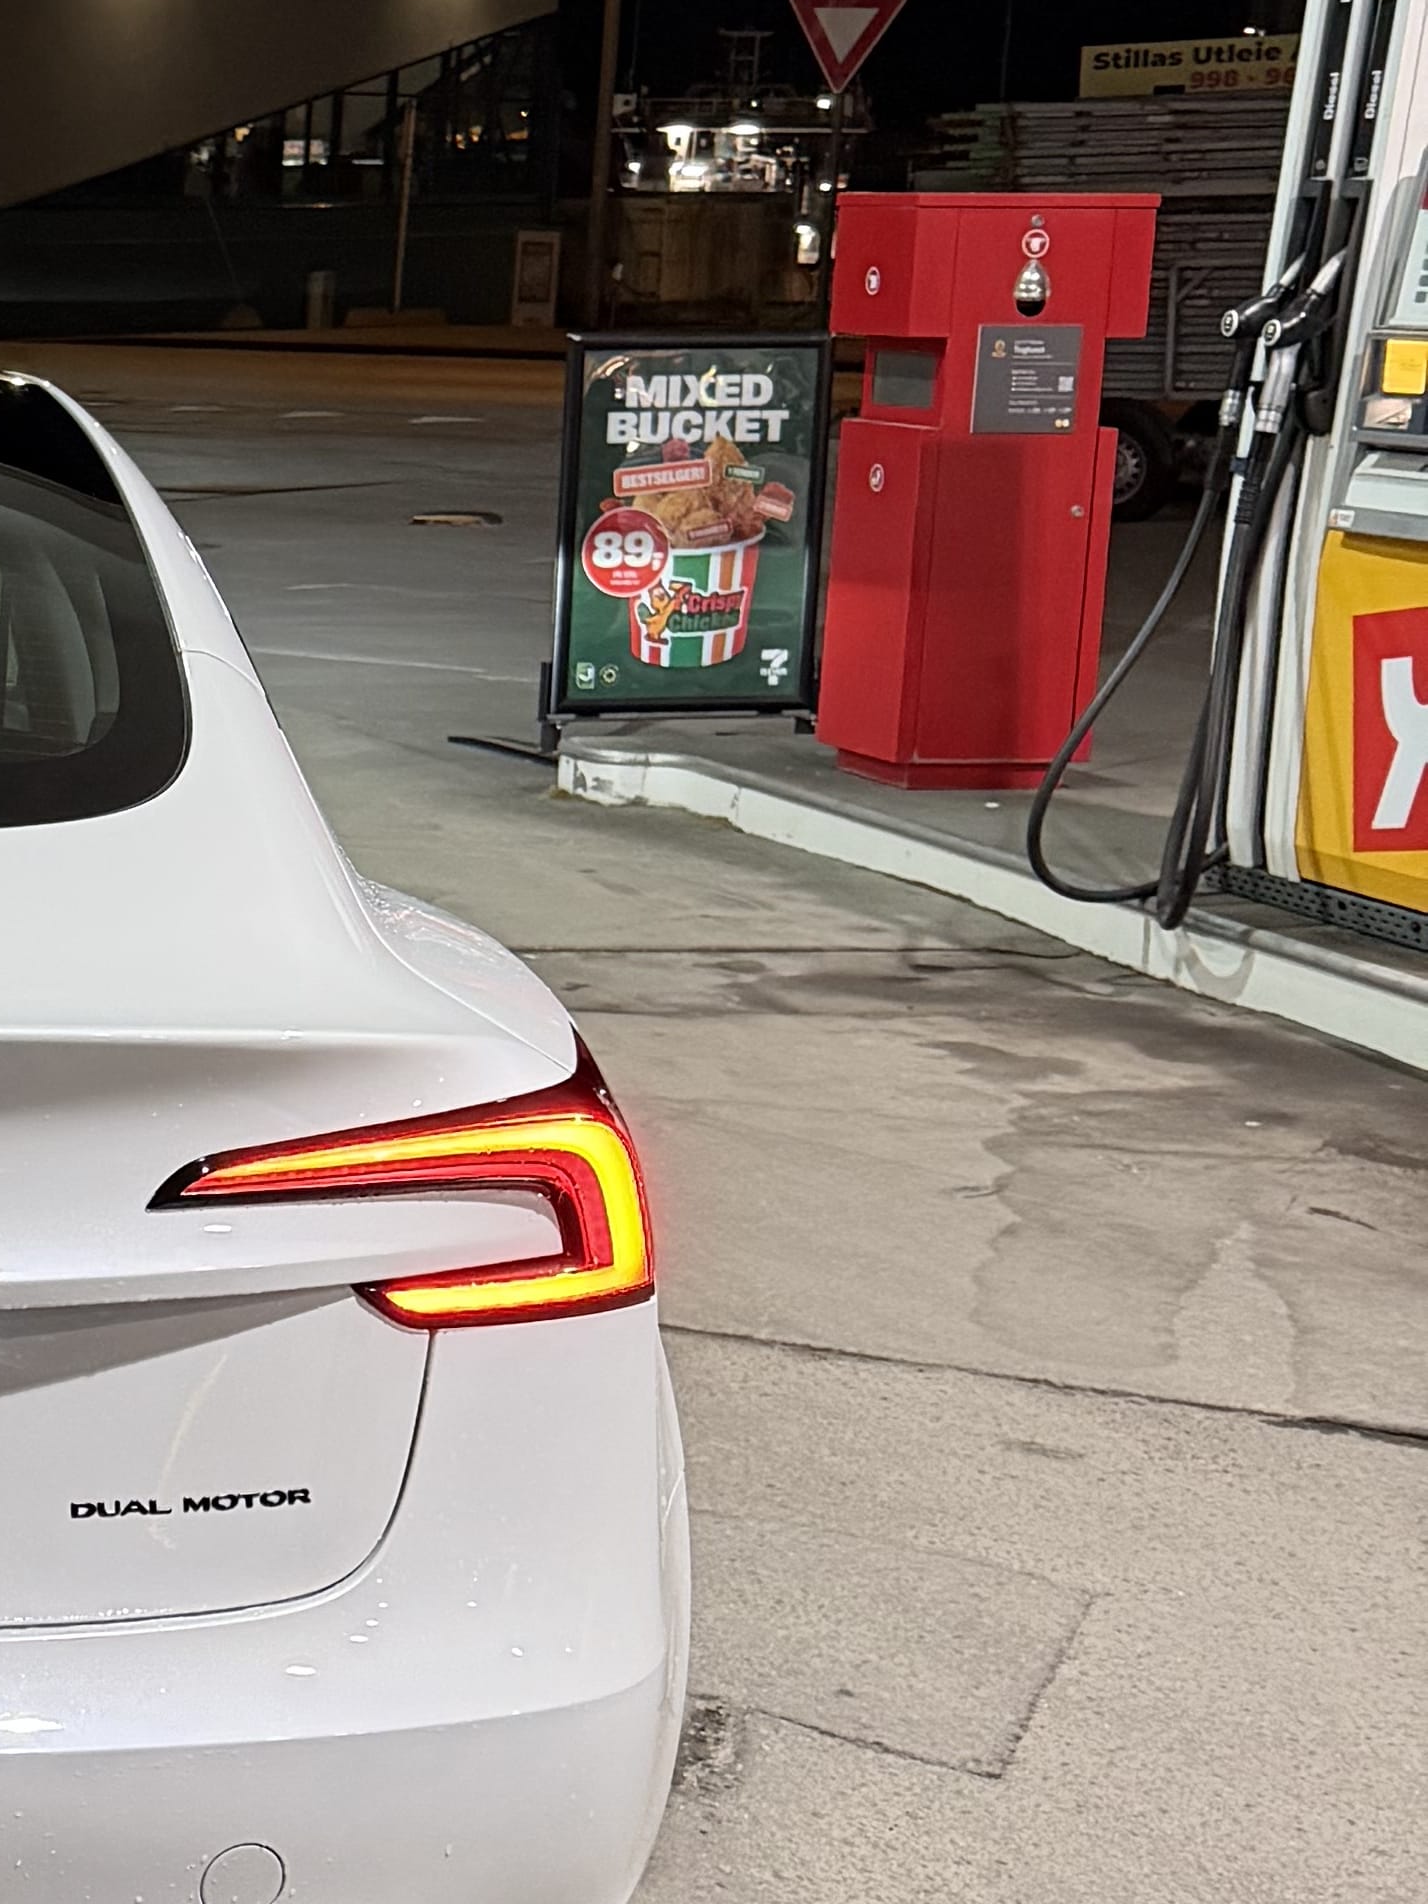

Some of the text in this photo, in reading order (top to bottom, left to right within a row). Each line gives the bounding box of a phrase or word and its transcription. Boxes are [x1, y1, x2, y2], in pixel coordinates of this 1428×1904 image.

[1093, 49, 1183, 70] Stillas
[1192, 41, 1283, 65] Utleie
[625, 374, 774, 408] MIXED
[606, 409, 790, 444] BUCKET
[70, 1488, 312, 1518] DUAL MOTOR
